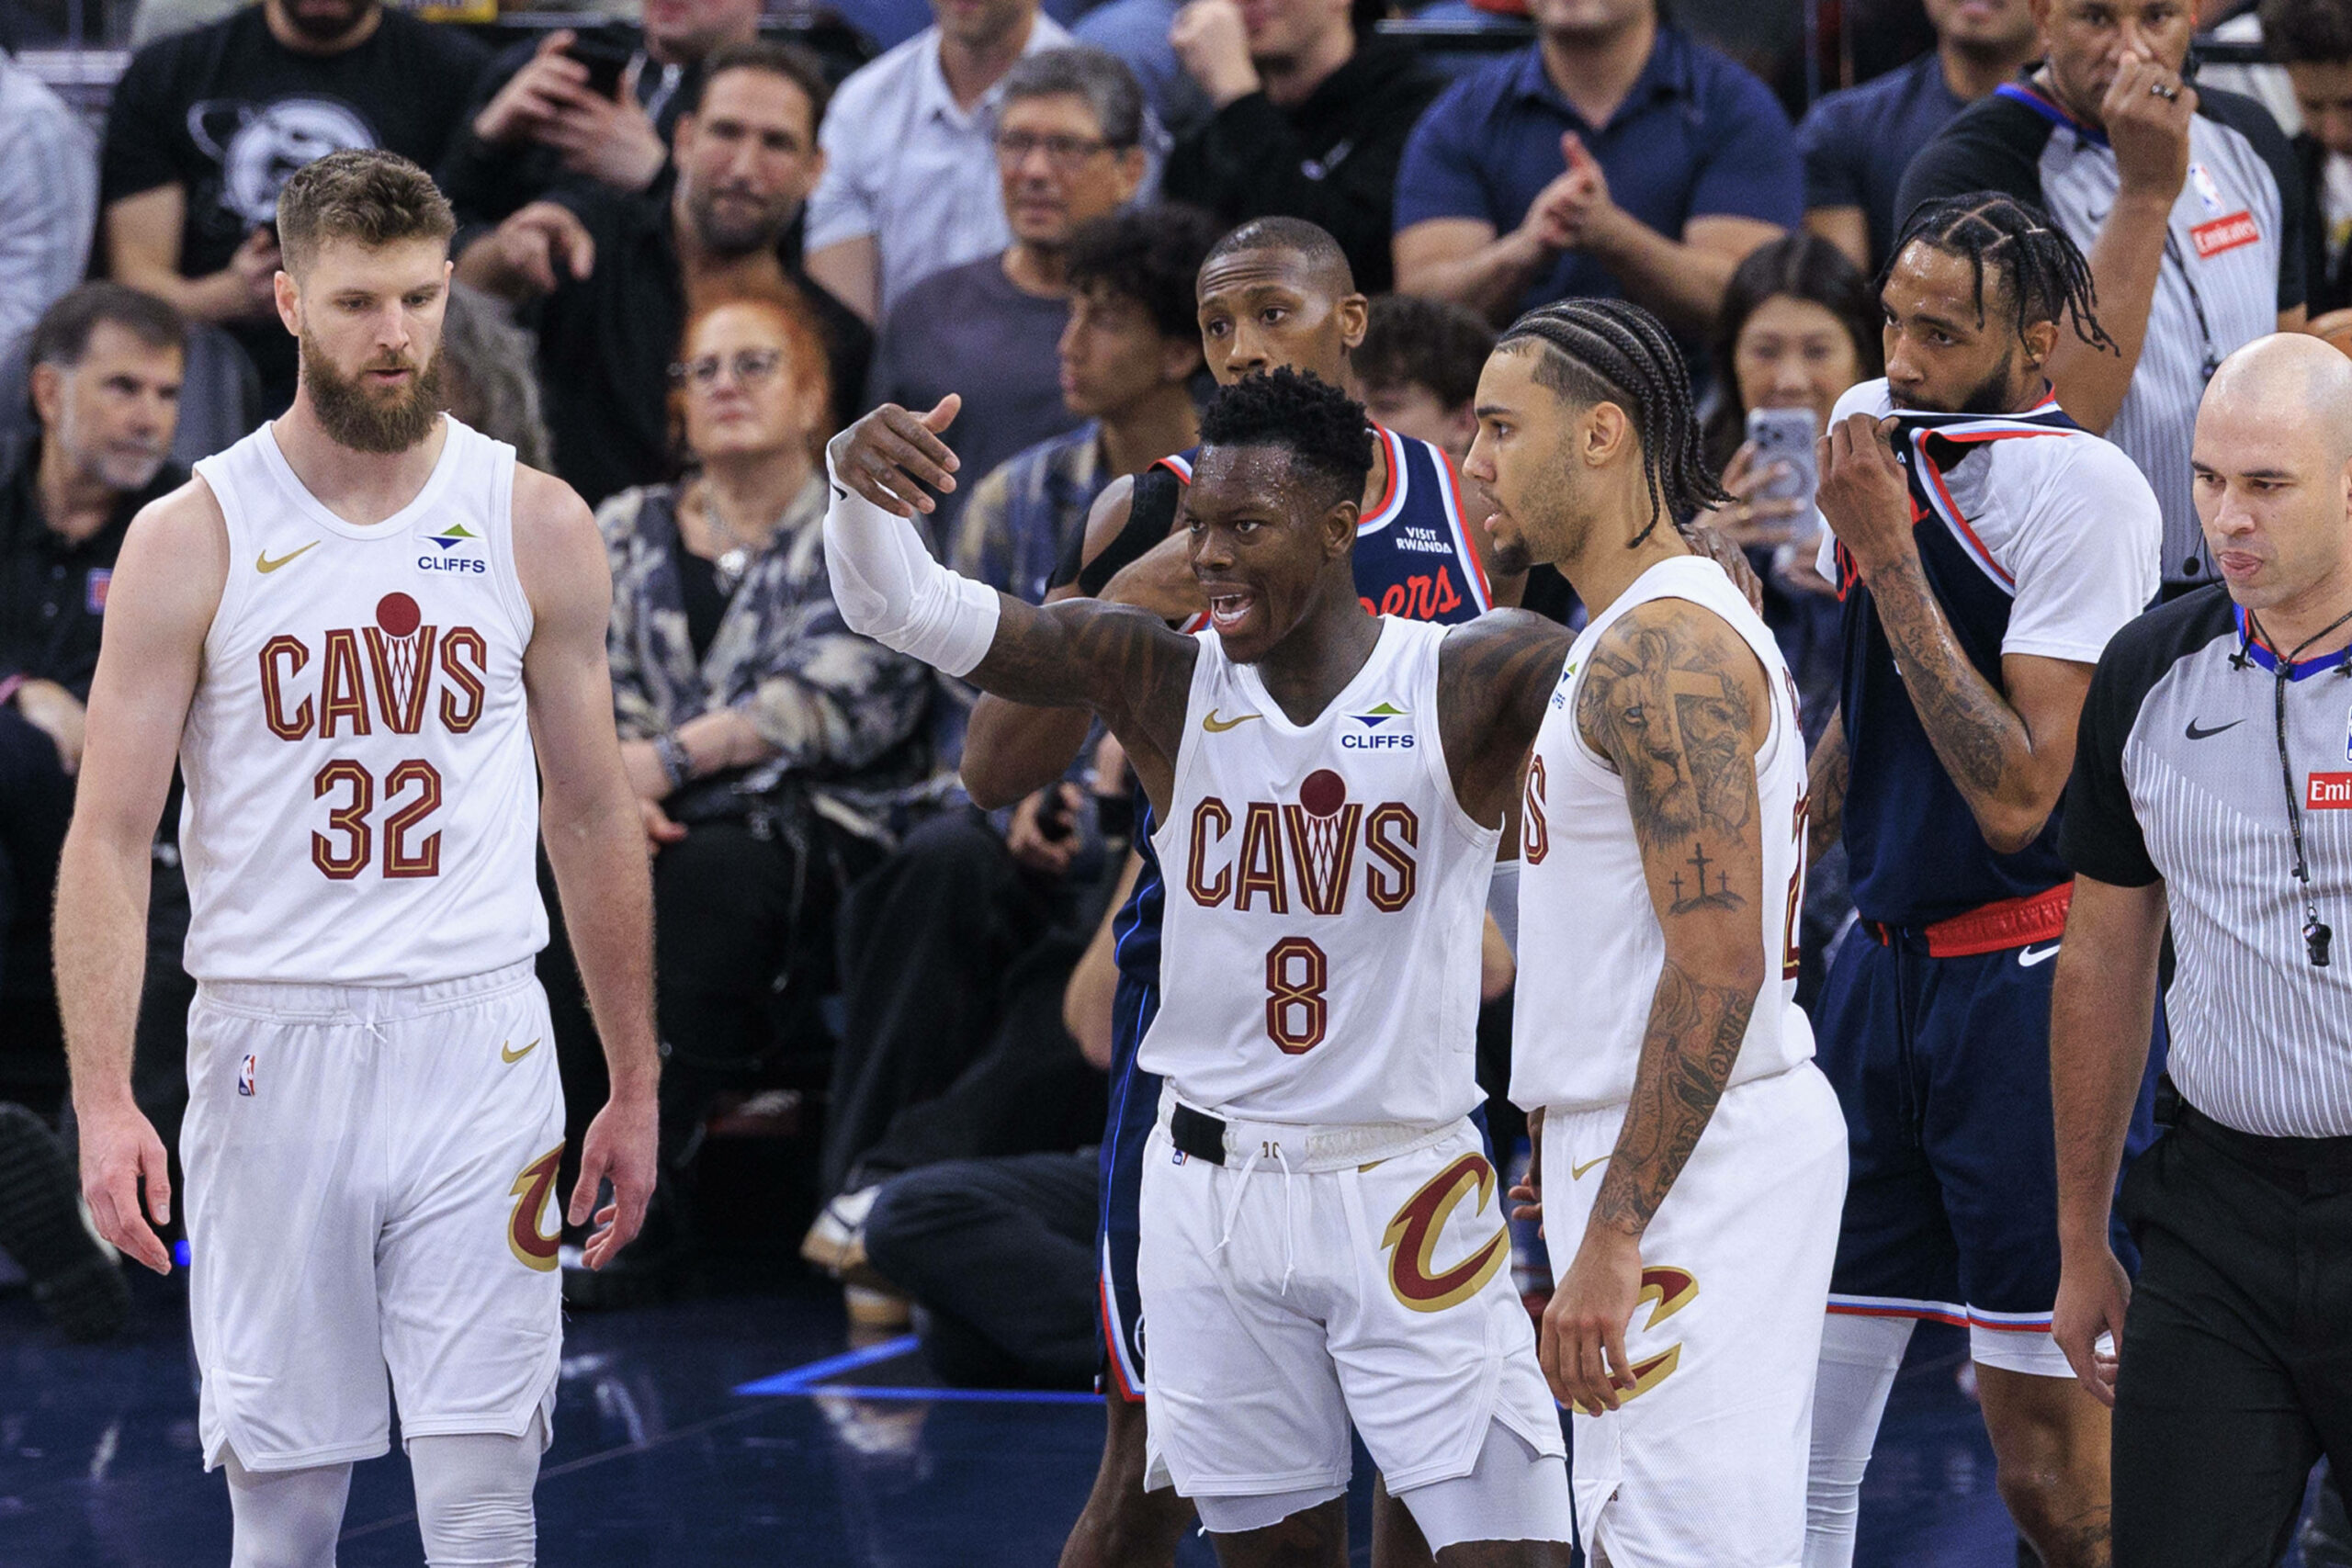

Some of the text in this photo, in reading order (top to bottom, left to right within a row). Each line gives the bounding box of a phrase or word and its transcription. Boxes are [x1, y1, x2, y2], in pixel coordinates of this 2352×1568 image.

[417, 556, 486, 573] CLIFFS
[1396, 537, 1453, 554] RWANDA
[1405, 526, 1437, 541] VISIT
[258, 626, 487, 741] CAVS
[1341, 734, 1415, 749] CLIFFS
[311, 759, 442, 880] 32
[1186, 795, 1419, 916] CAVS
[1266, 936, 1328, 1055] 8
